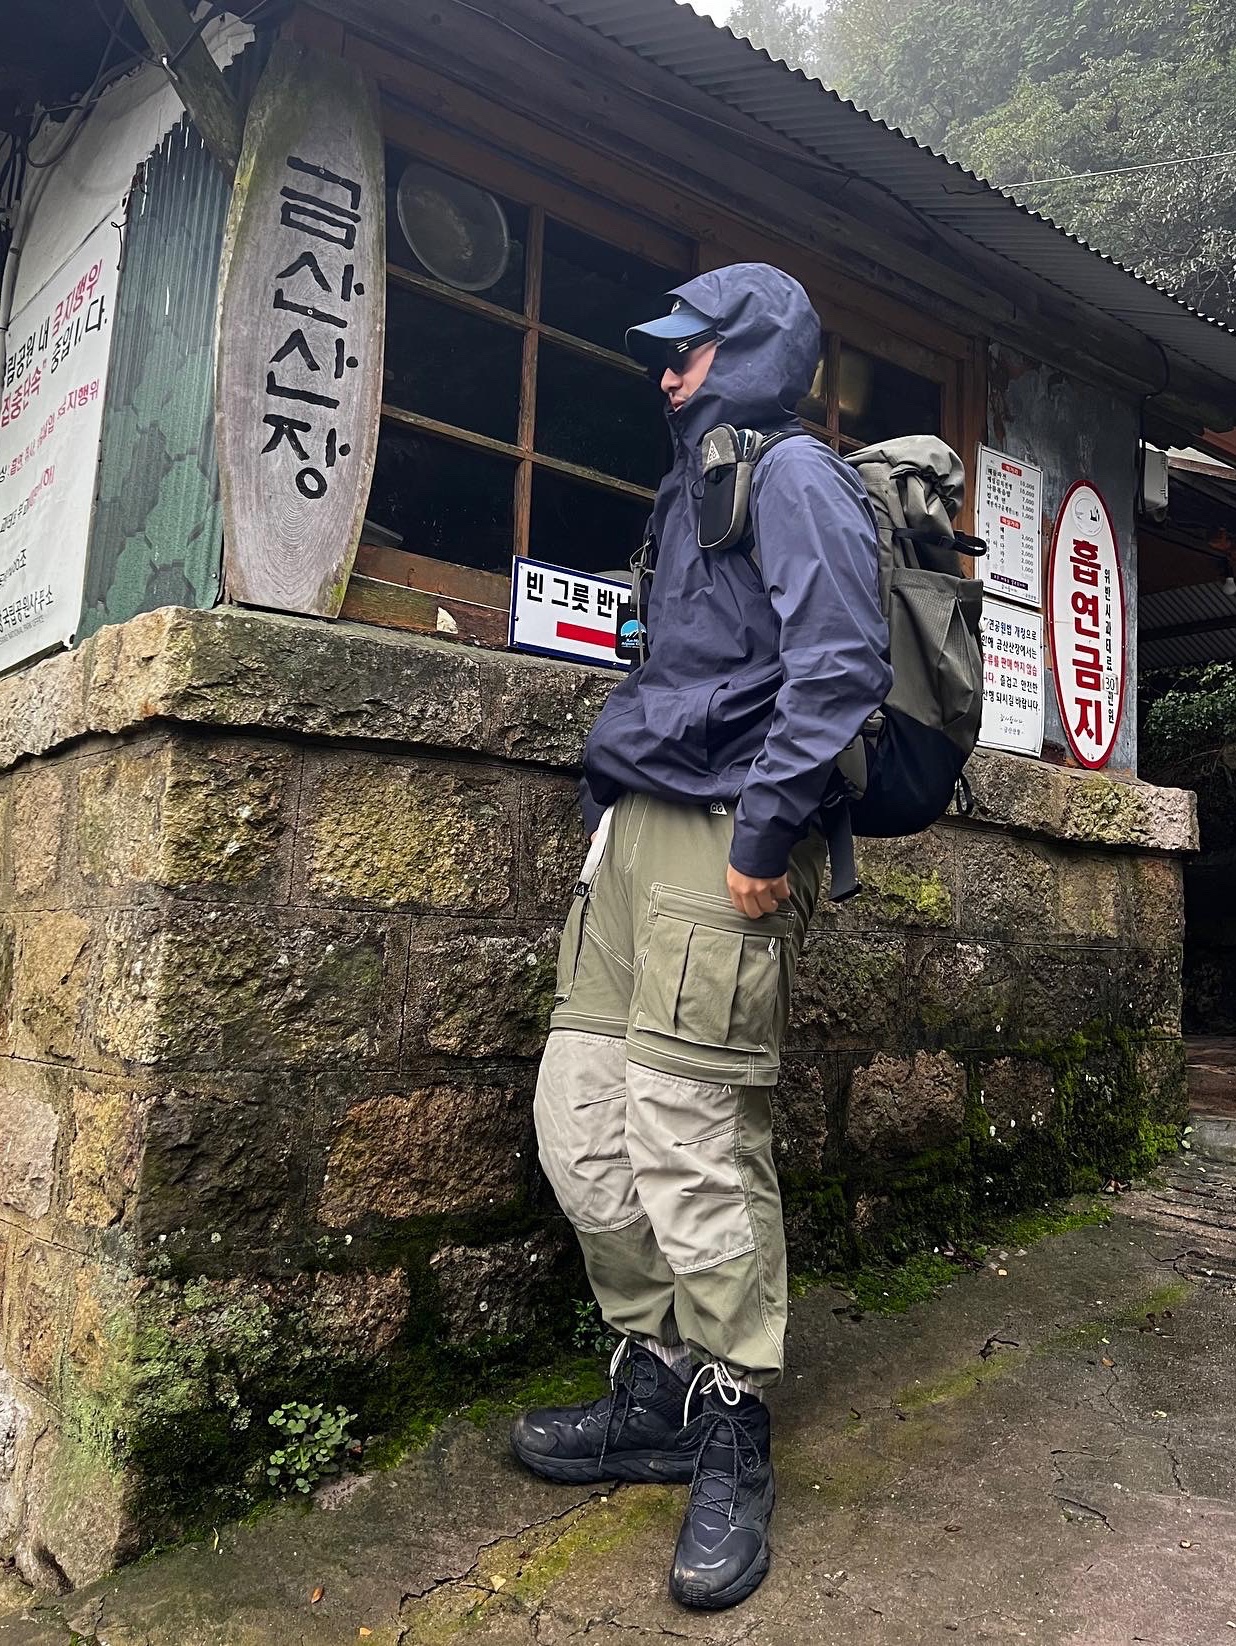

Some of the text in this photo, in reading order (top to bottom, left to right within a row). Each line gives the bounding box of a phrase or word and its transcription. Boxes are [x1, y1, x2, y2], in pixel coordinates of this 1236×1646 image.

[261, 155, 365, 500] 금산산장
[526, 571, 544, 602] 빈
[551, 577, 589, 613] 그릇
[983, 617, 1037, 640] 연공원법 개정으로
[1069, 538, 1104, 746] 흡연금지
[996, 638, 1037, 659] 금산산장에서는
[1000, 674, 1018, 689] 즐겁고
[1020, 679, 1038, 694] 안전한
